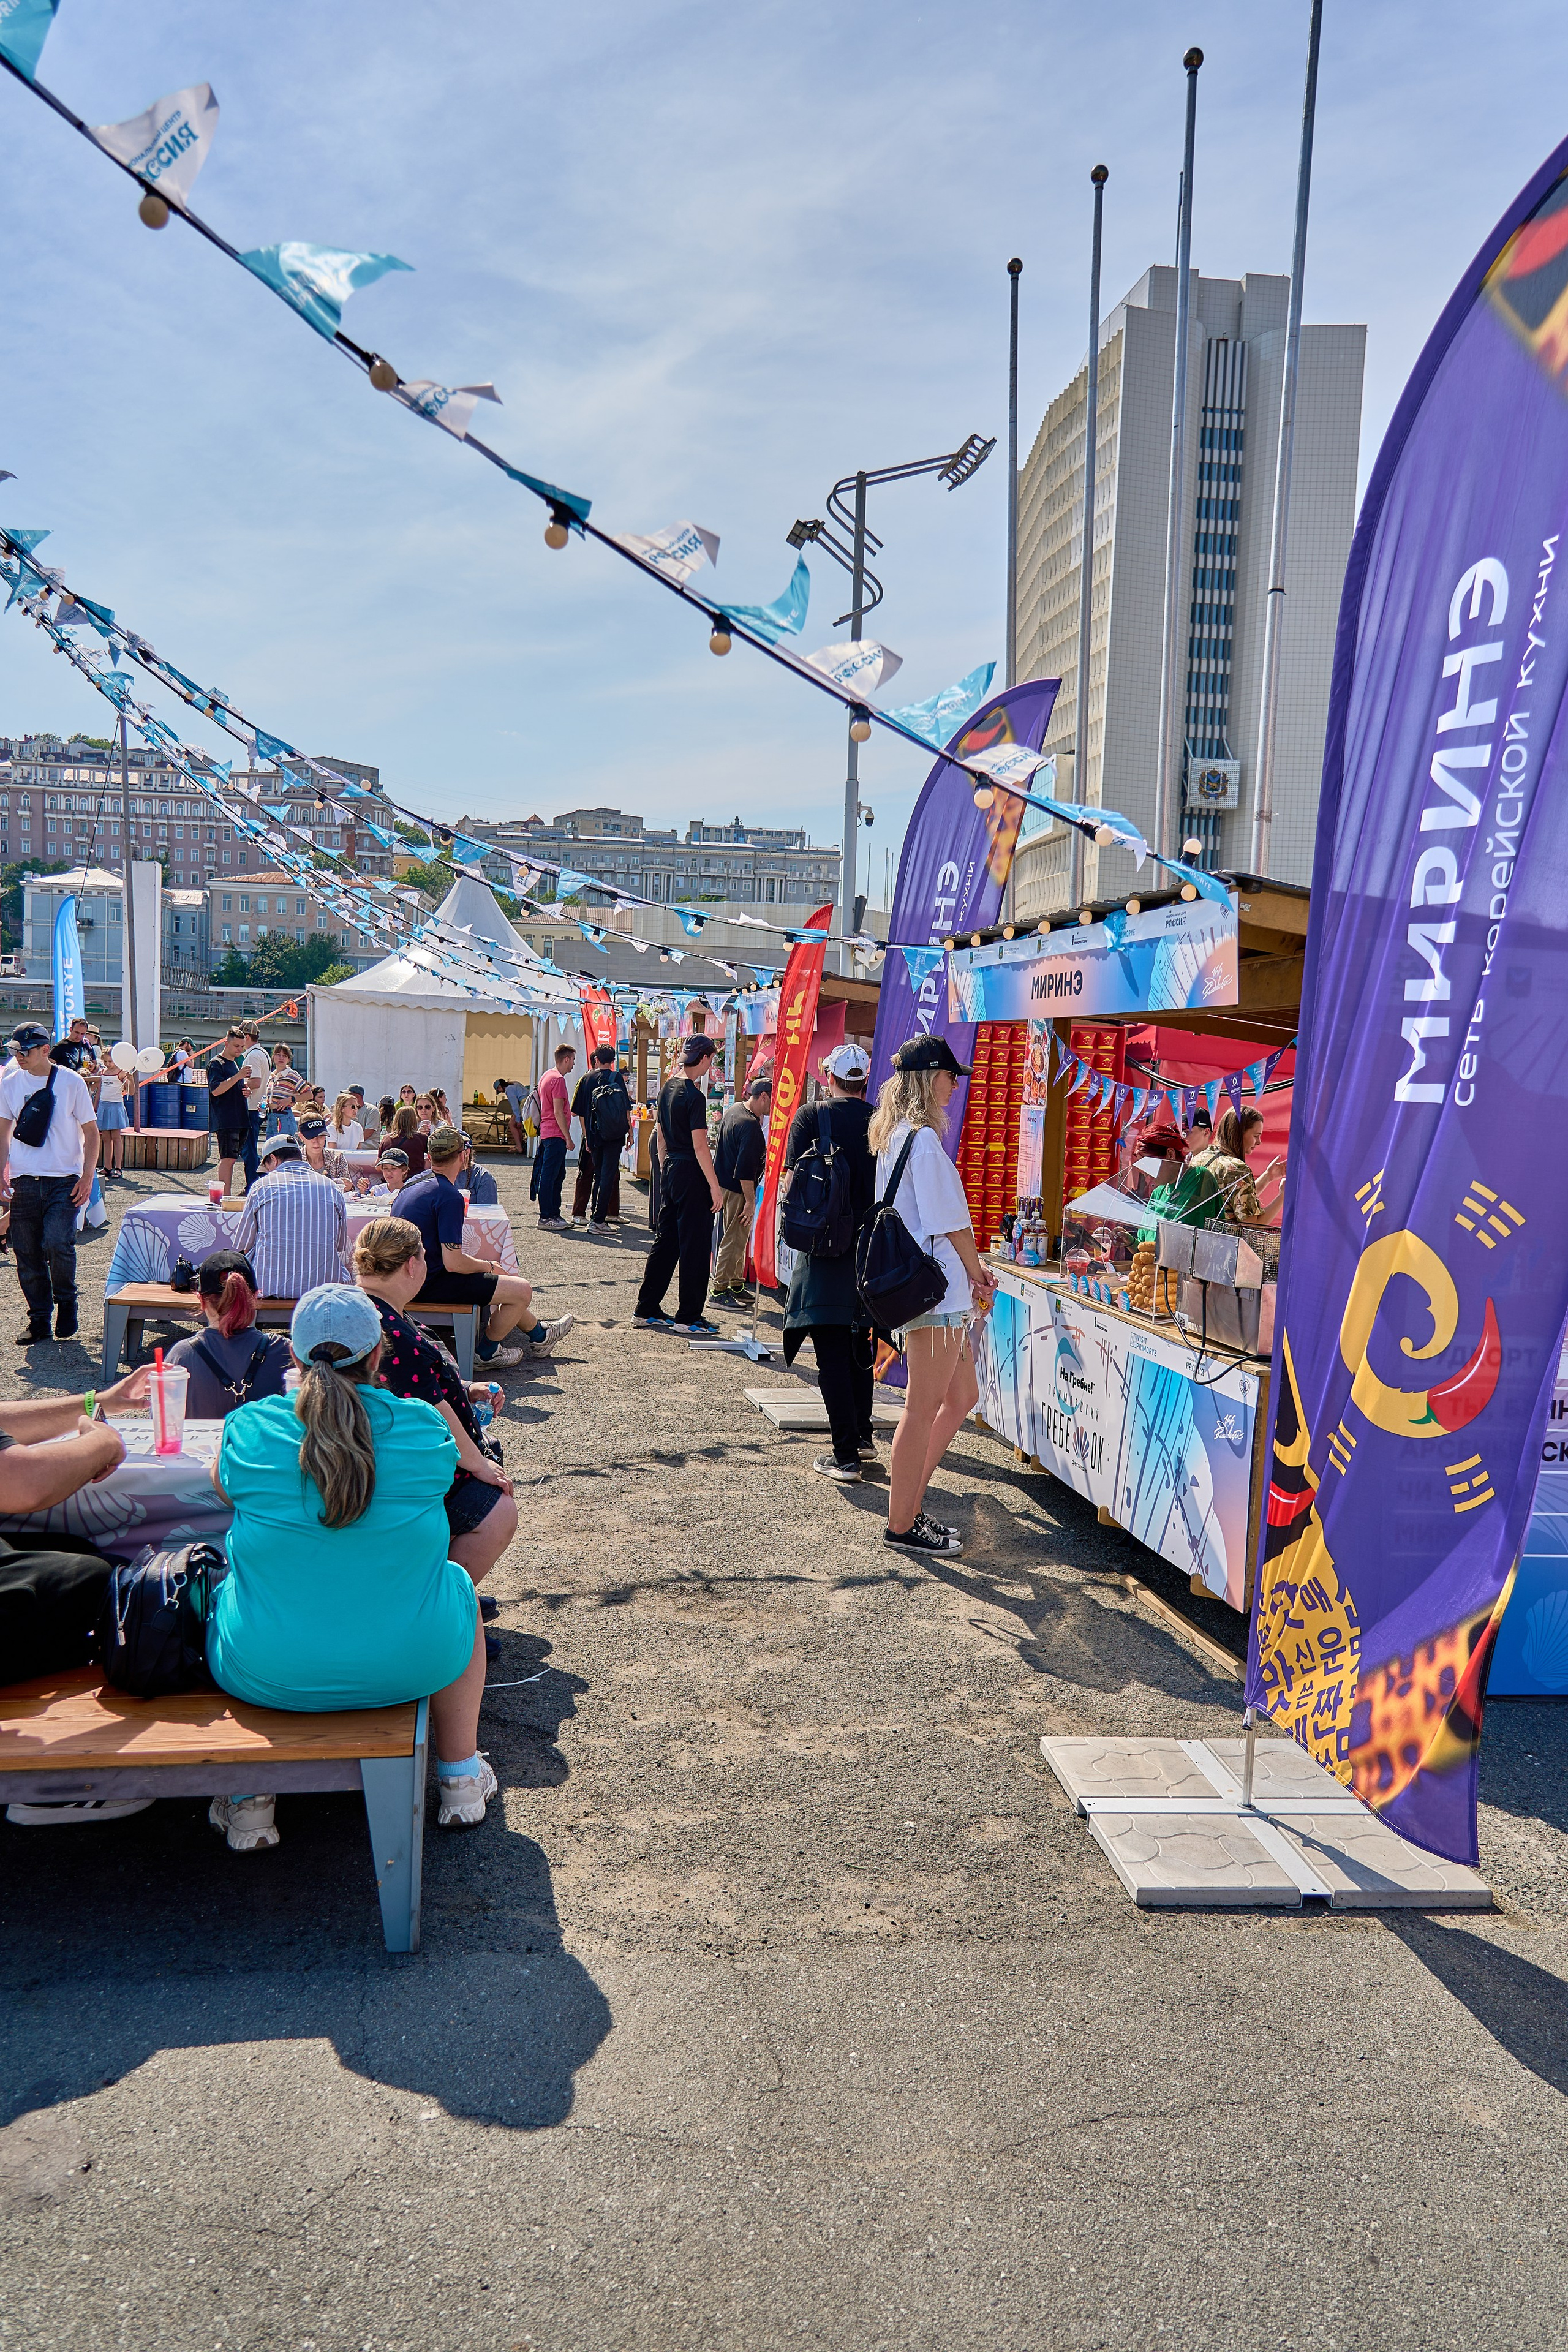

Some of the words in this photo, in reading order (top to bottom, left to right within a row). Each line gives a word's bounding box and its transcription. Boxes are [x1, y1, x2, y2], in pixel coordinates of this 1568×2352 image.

[1394, 557, 1509, 1104] МИРИНЭ
[1165, 916, 1186, 929] РОССИЯ
[1031, 970, 1083, 1000] МИРИНЭ
[1136, 1343, 1158, 1357] PRIMORYE
[1137, 1334, 1148, 1346] VISIT
[1047, 1383, 1099, 1422] ПРИМОРСКИЙ
